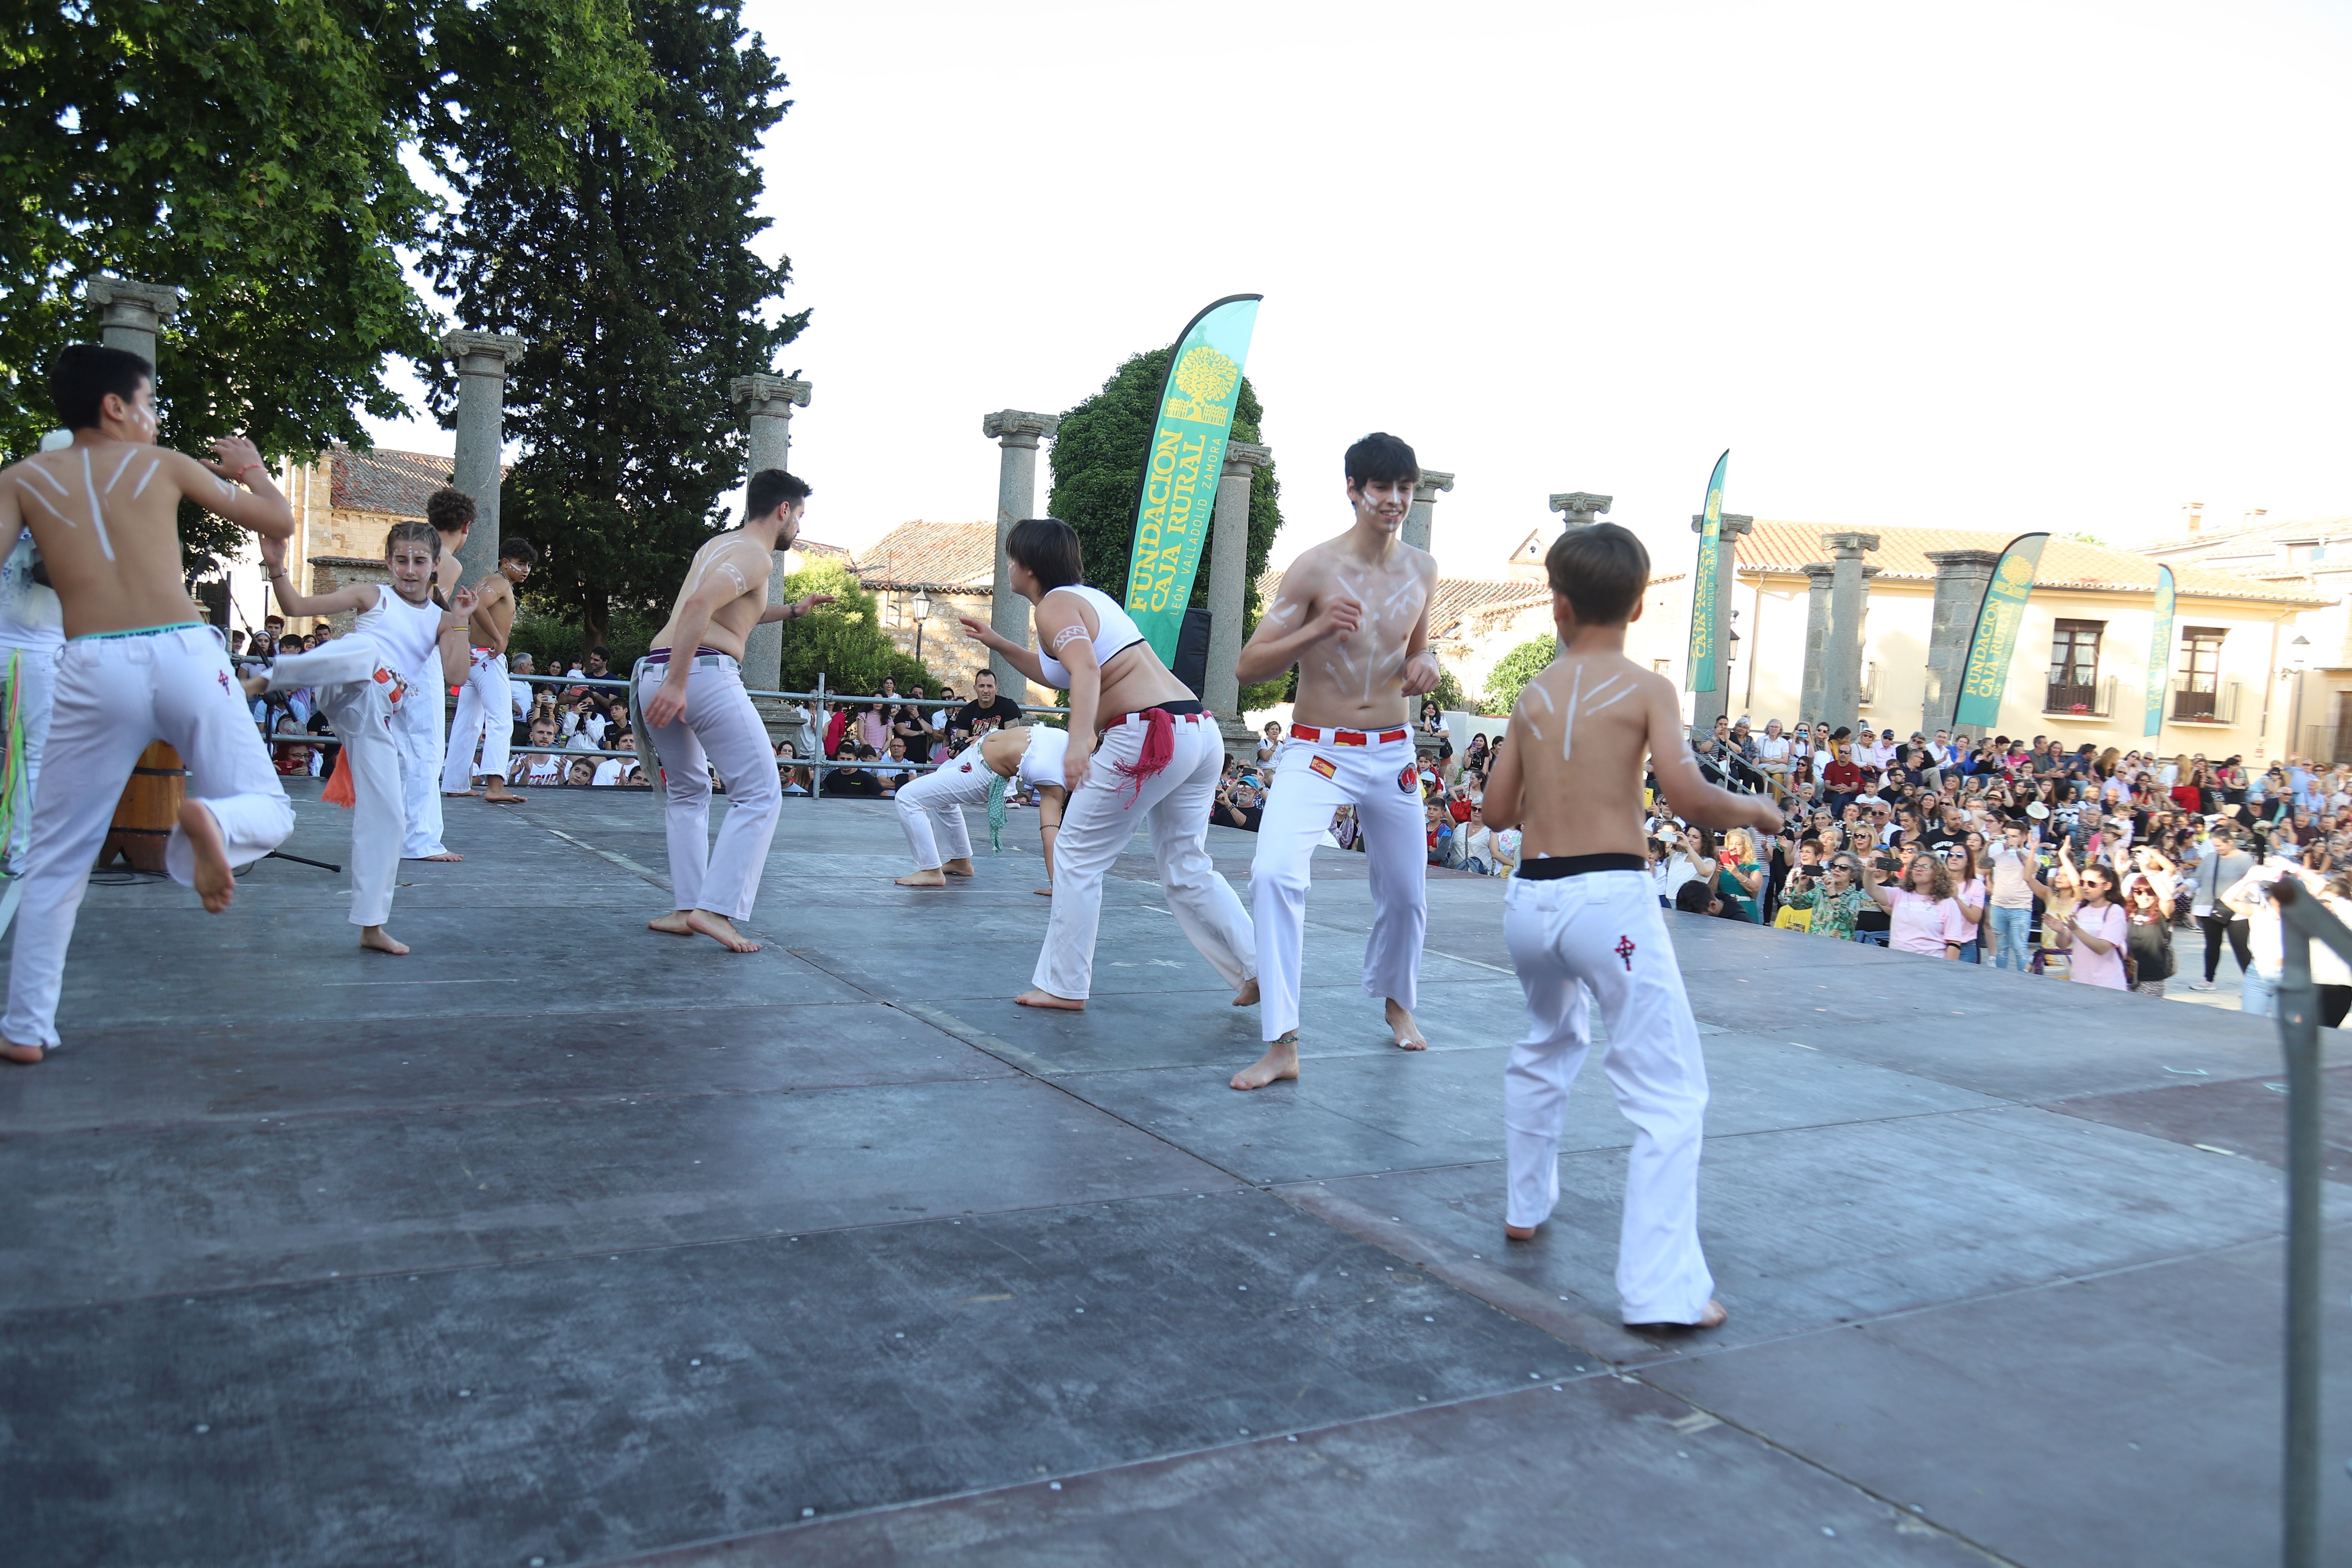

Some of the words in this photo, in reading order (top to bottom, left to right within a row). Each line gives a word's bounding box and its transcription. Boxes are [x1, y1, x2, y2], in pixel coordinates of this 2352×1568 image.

[1129, 428, 1183, 612] FUNDACION
[1151, 543, 1182, 612] CAJA
[1167, 435, 1206, 534] RURAL
[1170, 585, 1186, 615] LEÓN
[1181, 499, 1207, 574] VALLADOLID
[1202, 439, 1222, 489] ZAMORA
[1696, 612, 1707, 657] CAJA
[1965, 596, 2003, 695] FUNDACION
[1989, 603, 2015, 655] RURAL
[1980, 661, 1999, 697] CAJA
[1931, 841, 1954, 850] SUPER
